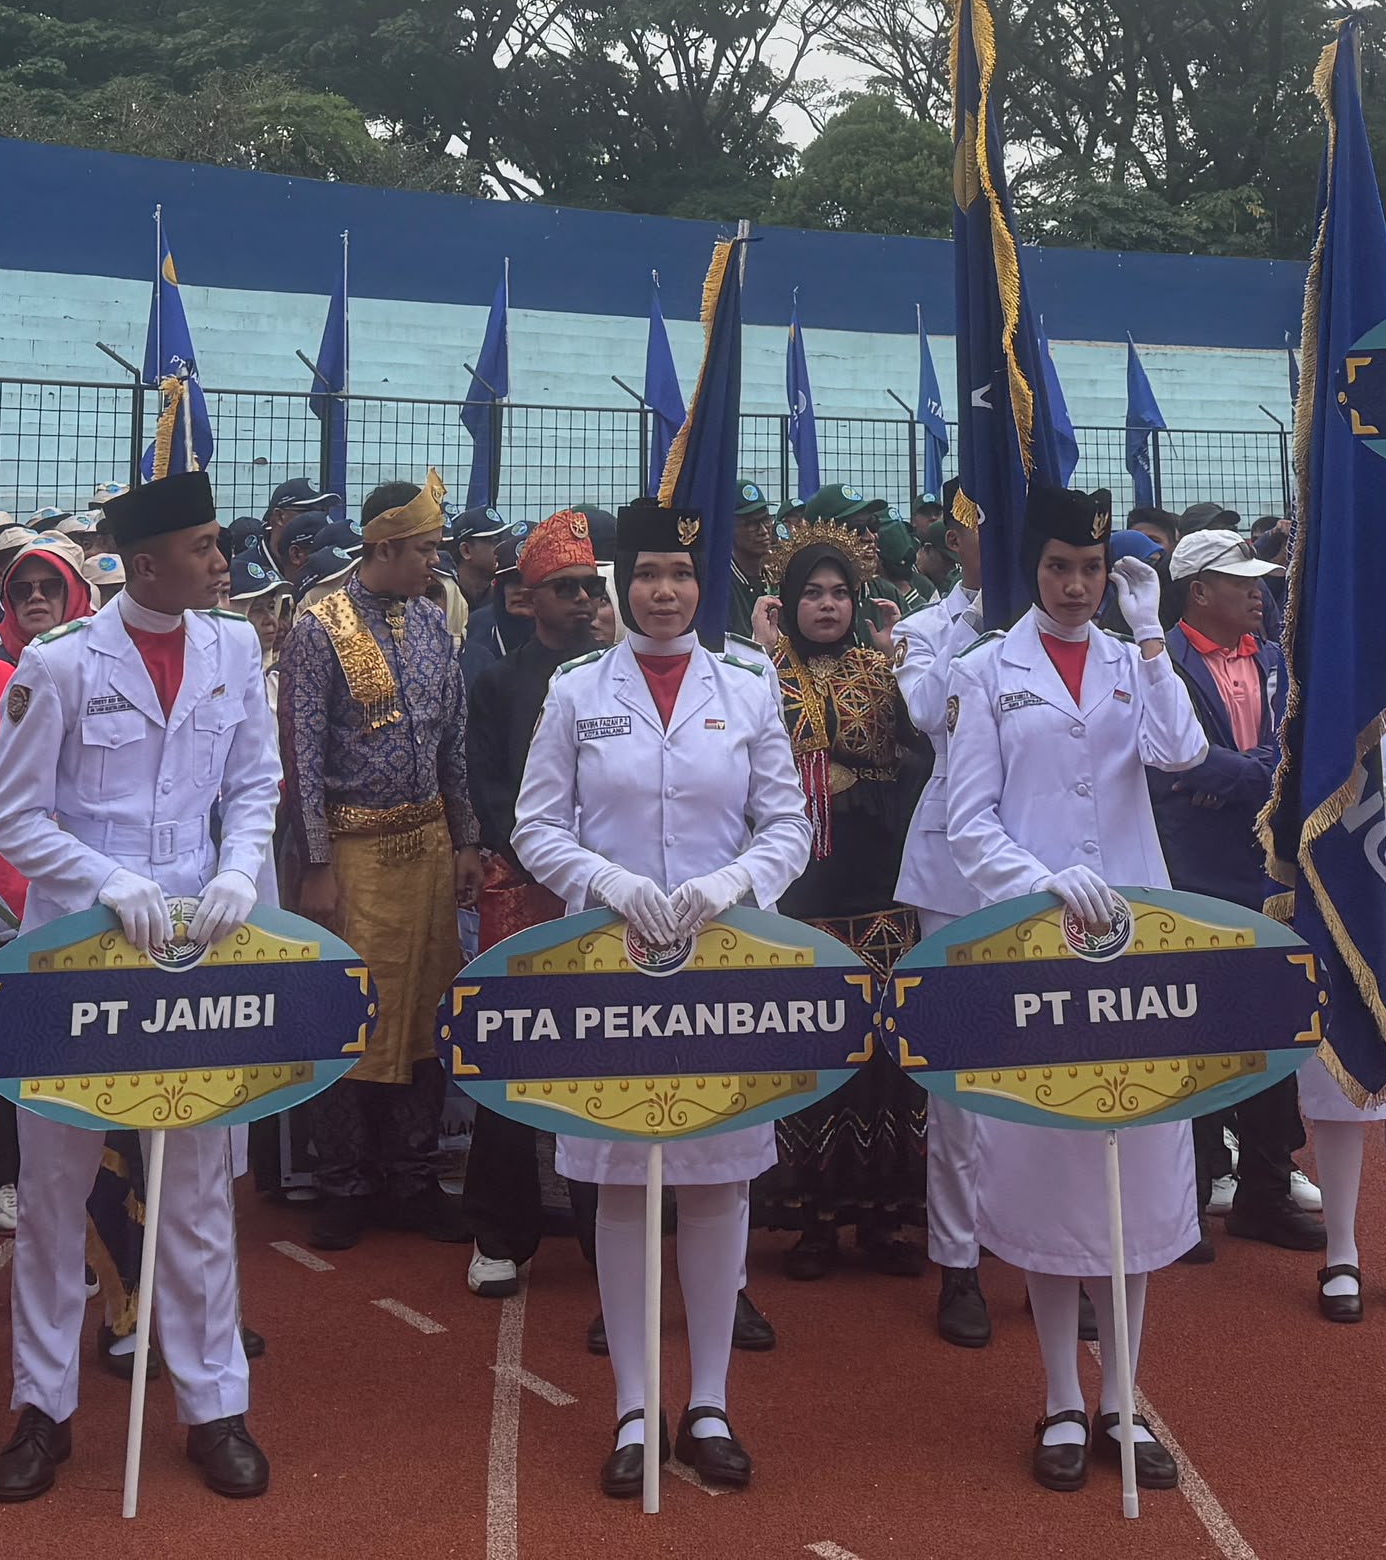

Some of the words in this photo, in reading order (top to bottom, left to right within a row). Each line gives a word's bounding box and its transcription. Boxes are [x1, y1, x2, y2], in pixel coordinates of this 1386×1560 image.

[70, 1000, 129, 1037] PT
[141, 993, 275, 1033] JAMBI
[477, 1008, 561, 1042] PTA
[575, 999, 848, 1039] PEKANBARU
[1014, 991, 1072, 1028] PT
[1087, 983, 1198, 1023] RIAU
